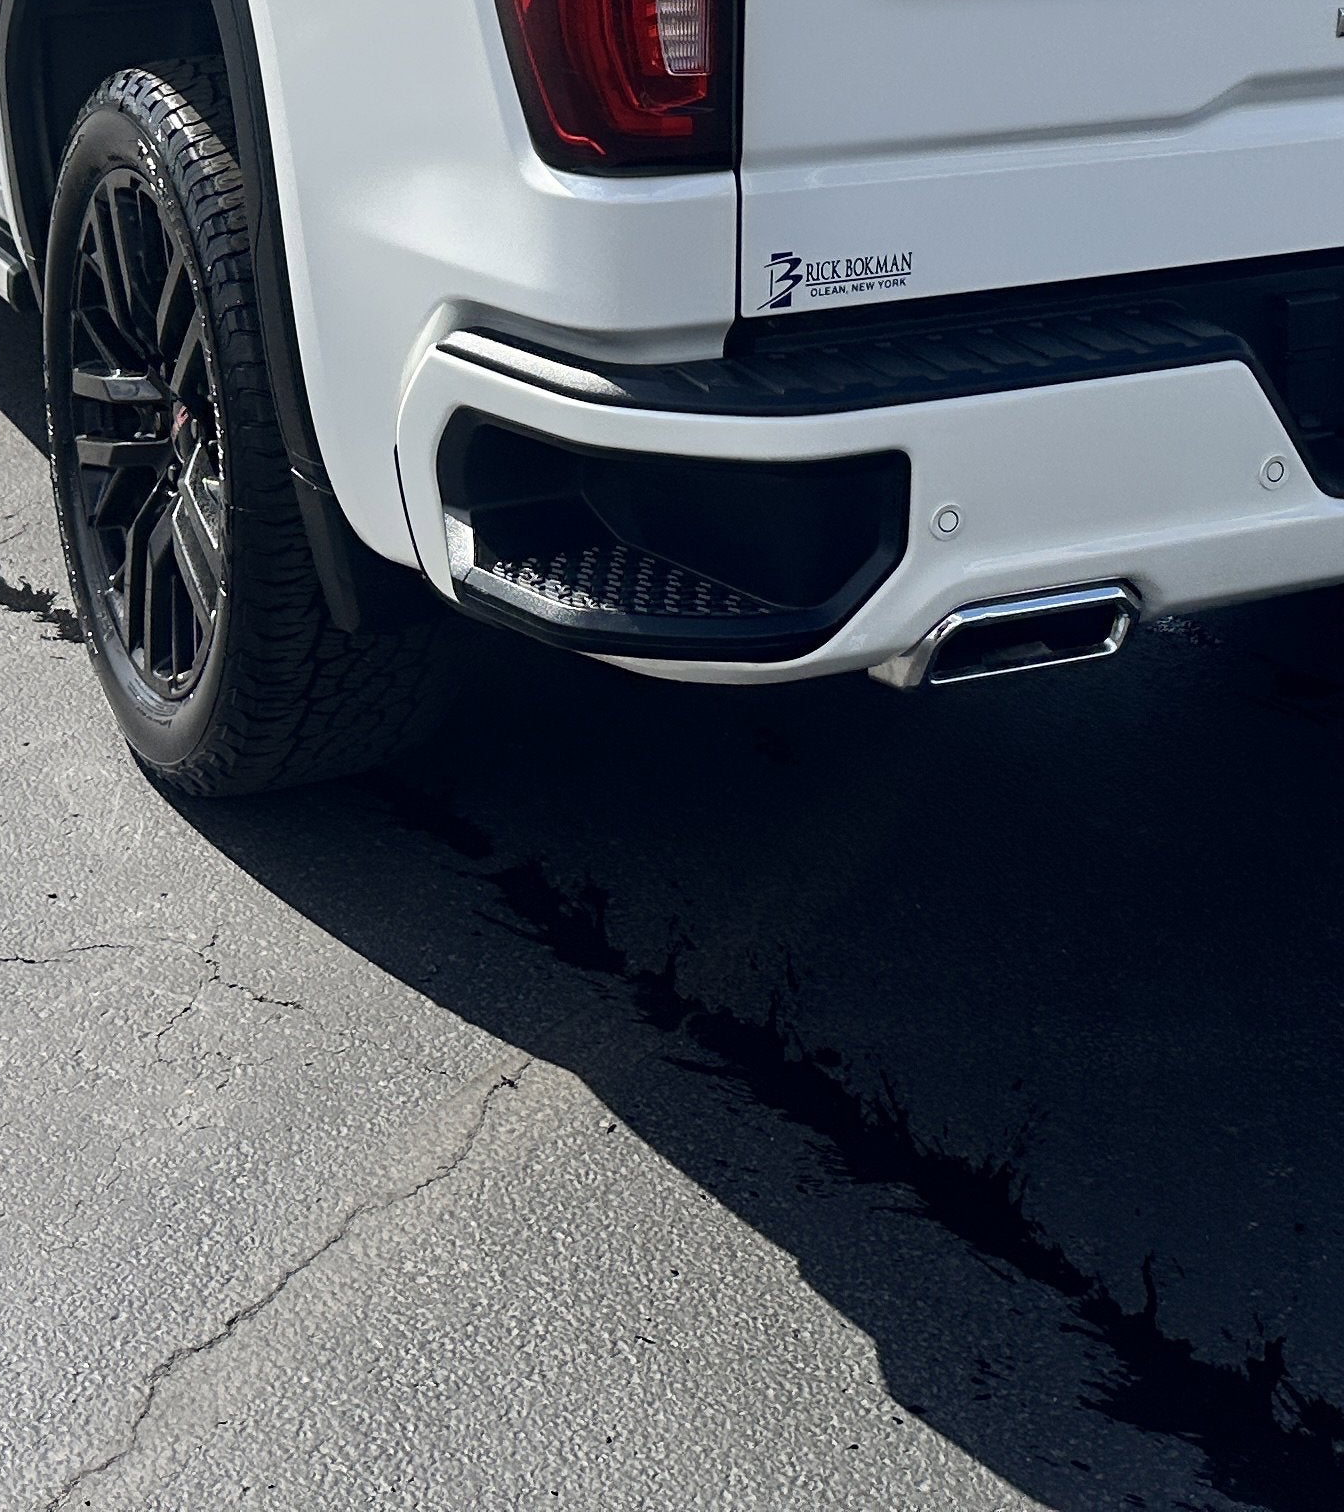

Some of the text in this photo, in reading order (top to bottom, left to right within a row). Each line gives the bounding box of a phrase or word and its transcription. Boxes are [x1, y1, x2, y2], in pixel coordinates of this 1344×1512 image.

[805, 251, 913, 282] RICK BOKMAN
[810, 277, 907, 297] OLEAN, NEW YORK
